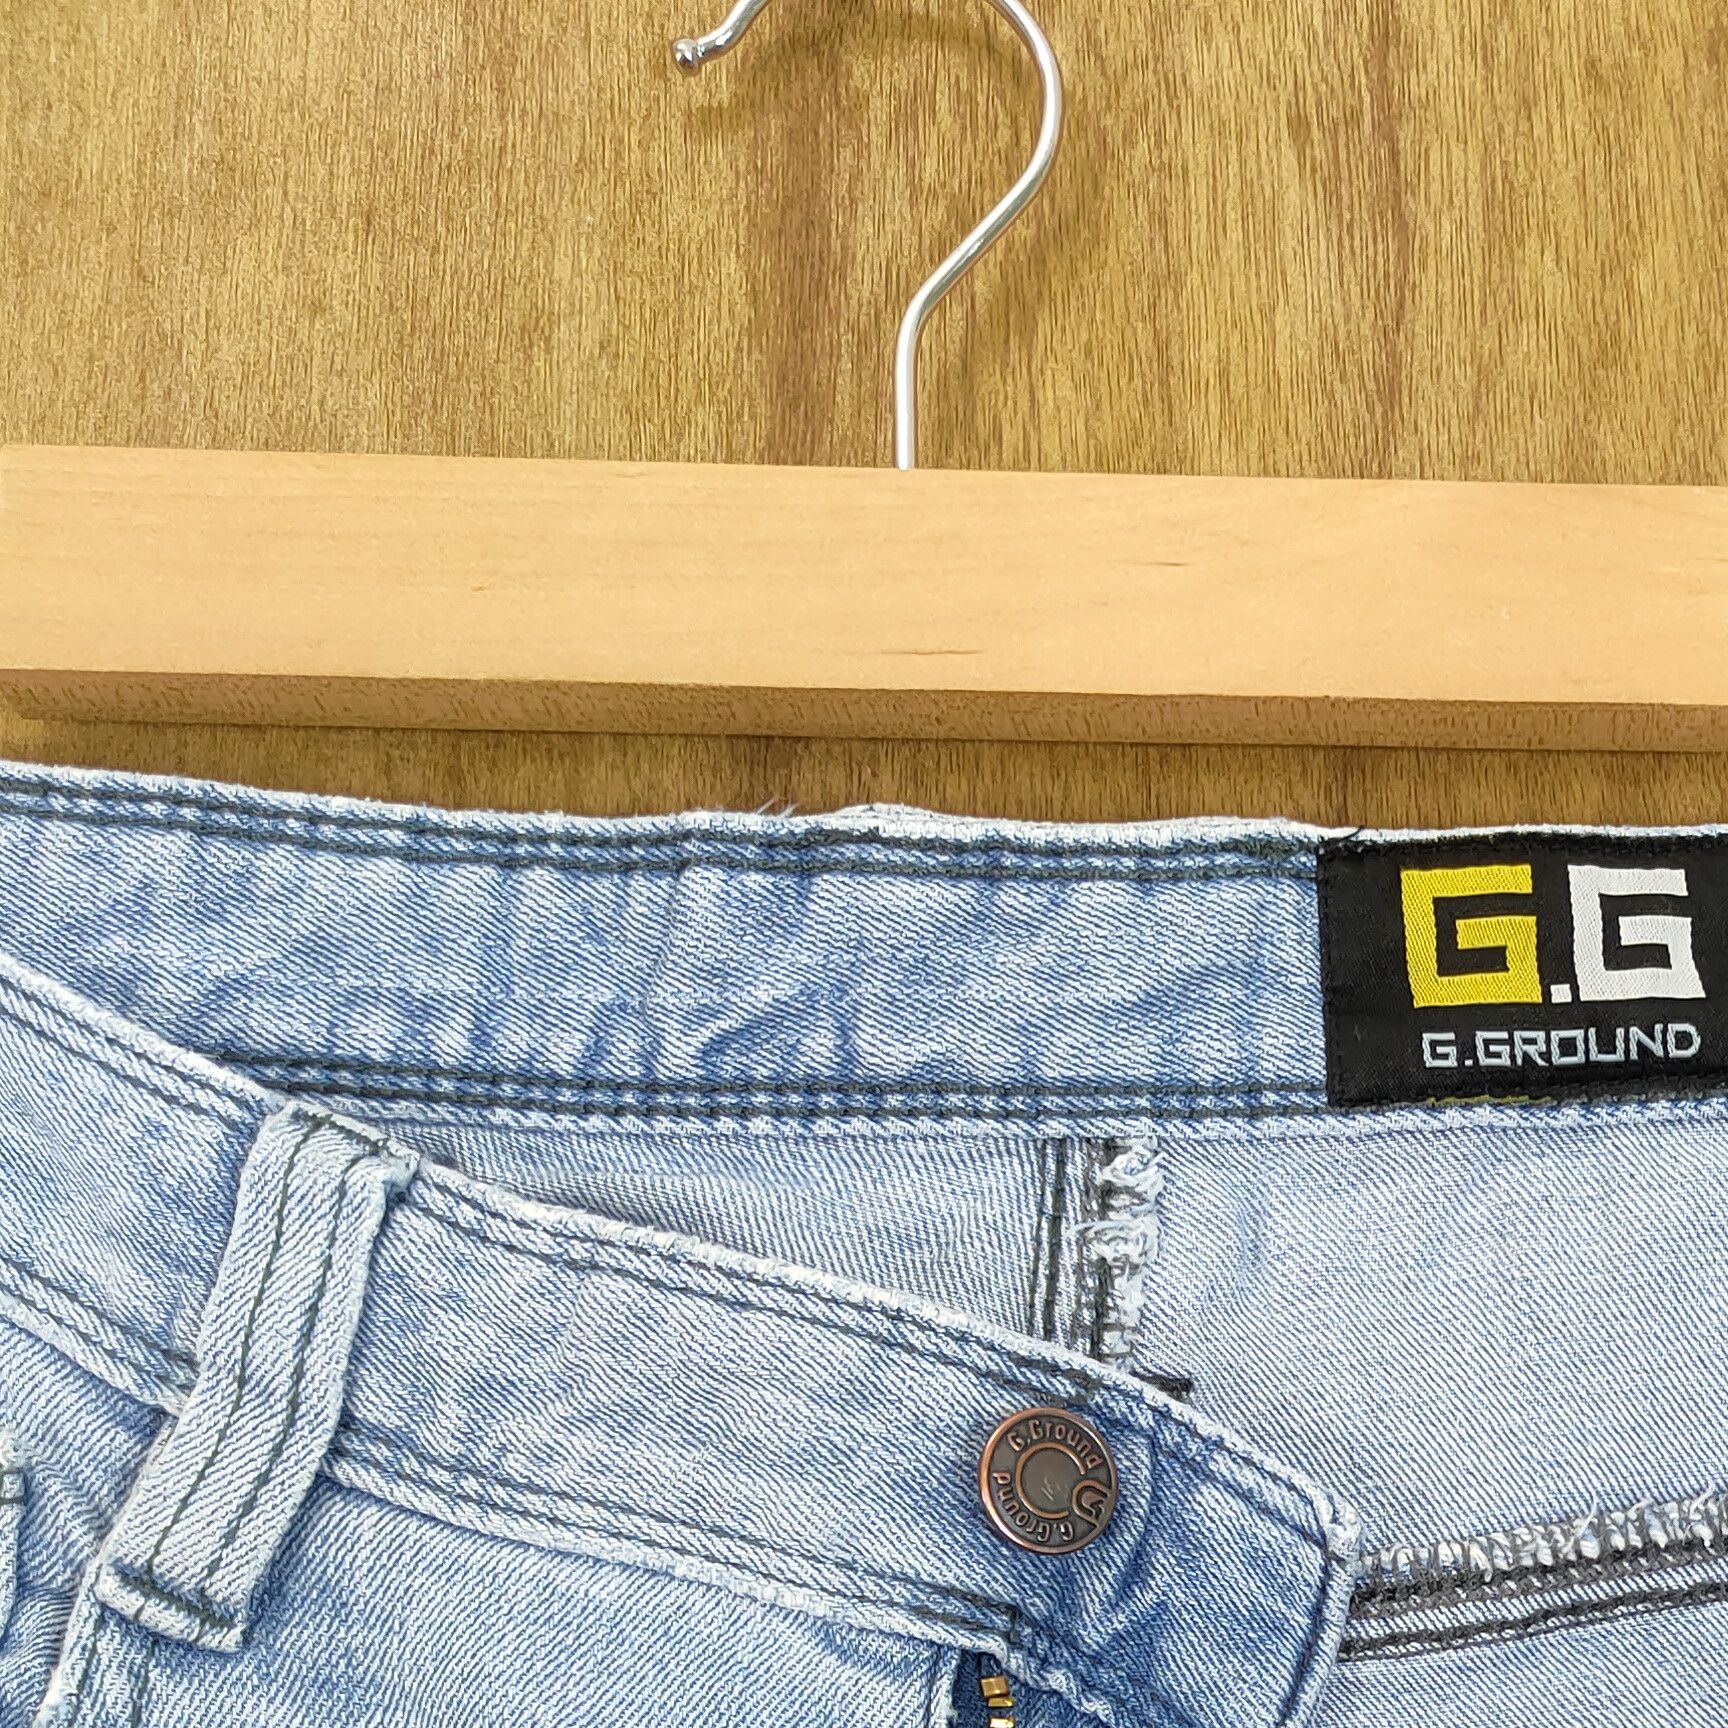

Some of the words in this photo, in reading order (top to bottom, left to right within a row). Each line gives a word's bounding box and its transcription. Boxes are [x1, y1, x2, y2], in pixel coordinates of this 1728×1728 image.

[1401, 863, 1706, 1008] G.G
[1422, 1022, 1701, 1068] G.GROUND
[1006, 1418, 1104, 1470] G.Ground
